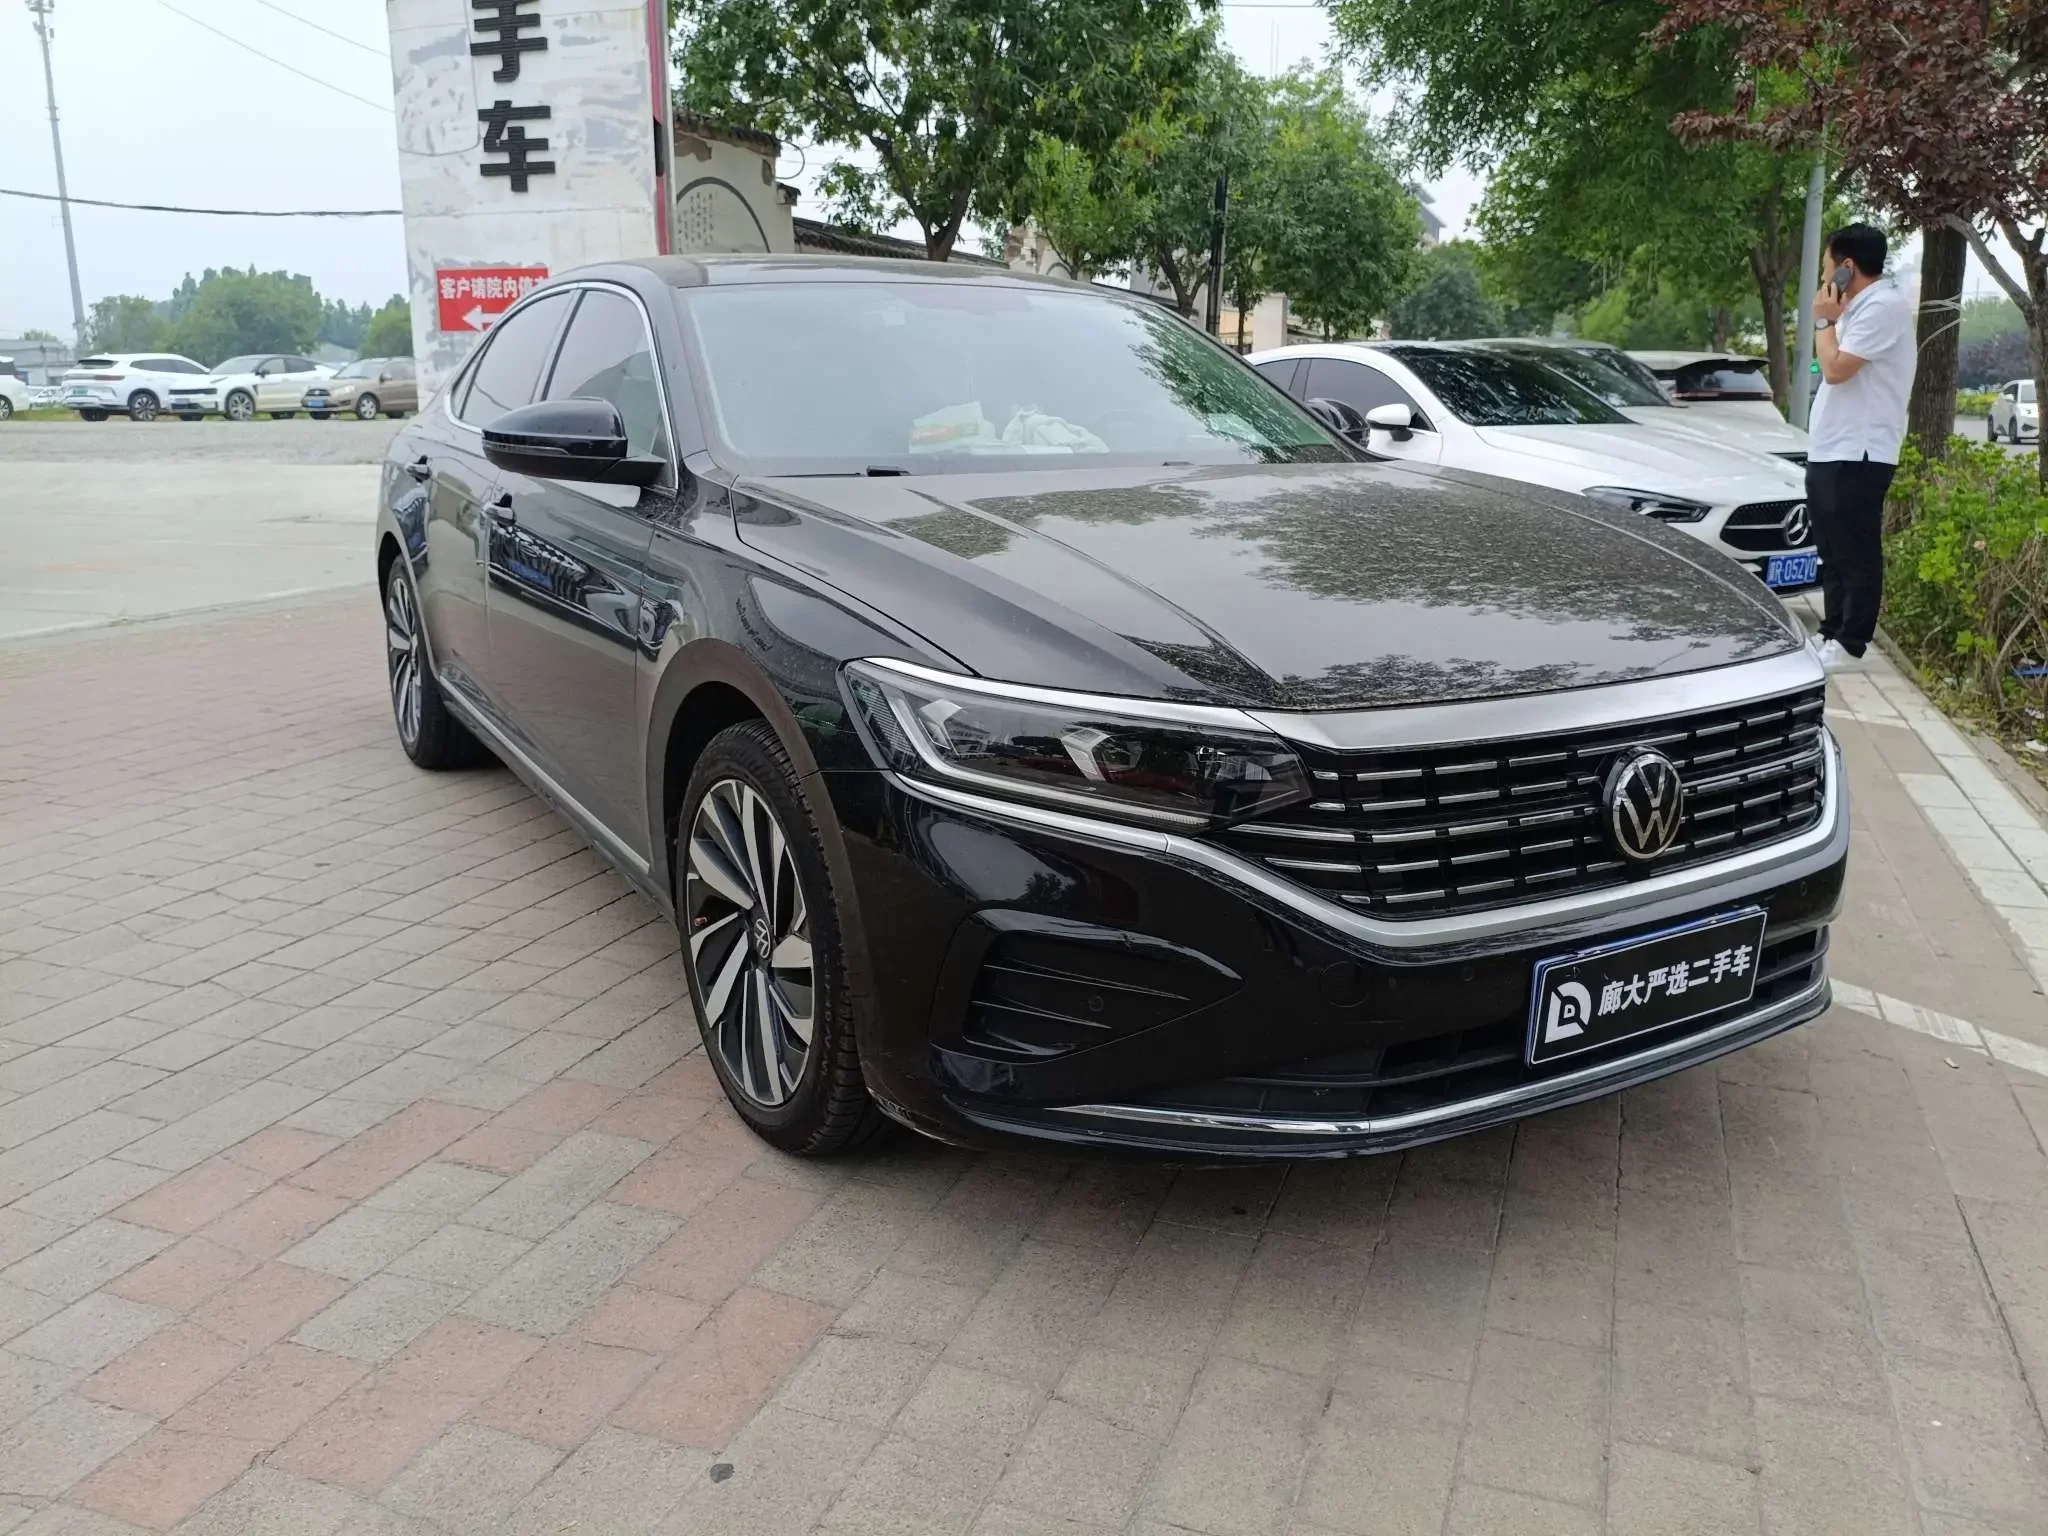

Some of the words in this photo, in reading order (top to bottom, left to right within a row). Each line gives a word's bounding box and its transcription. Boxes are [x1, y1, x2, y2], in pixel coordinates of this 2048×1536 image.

[470, 0, 556, 193] 手车
[1598, 944, 1753, 1017] 廊大严选二手车
